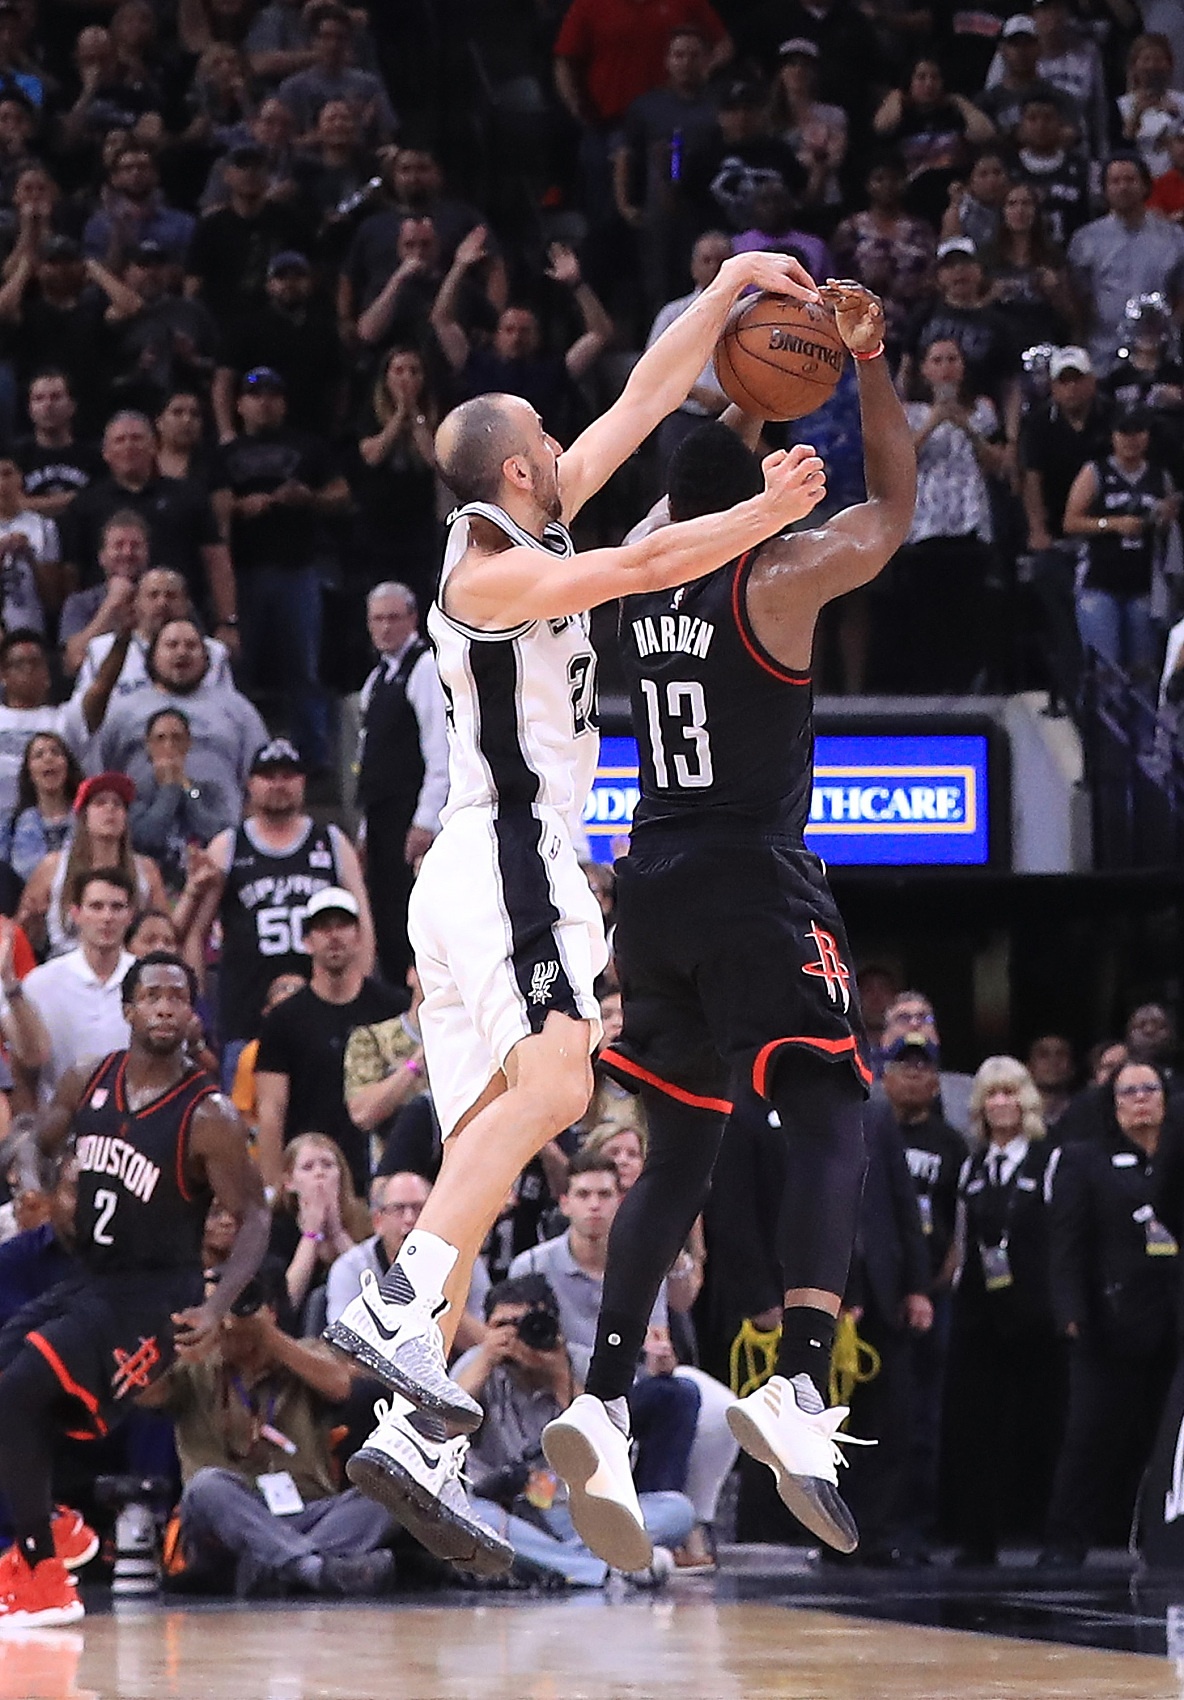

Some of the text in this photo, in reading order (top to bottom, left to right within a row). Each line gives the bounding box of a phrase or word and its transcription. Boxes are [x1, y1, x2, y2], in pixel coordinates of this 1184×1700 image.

[632, 615, 715, 660] HARDEN
[641, 678, 714, 788] 13
[811, 786, 963, 821] THCARE
[93, 1188, 119, 1245] 2
